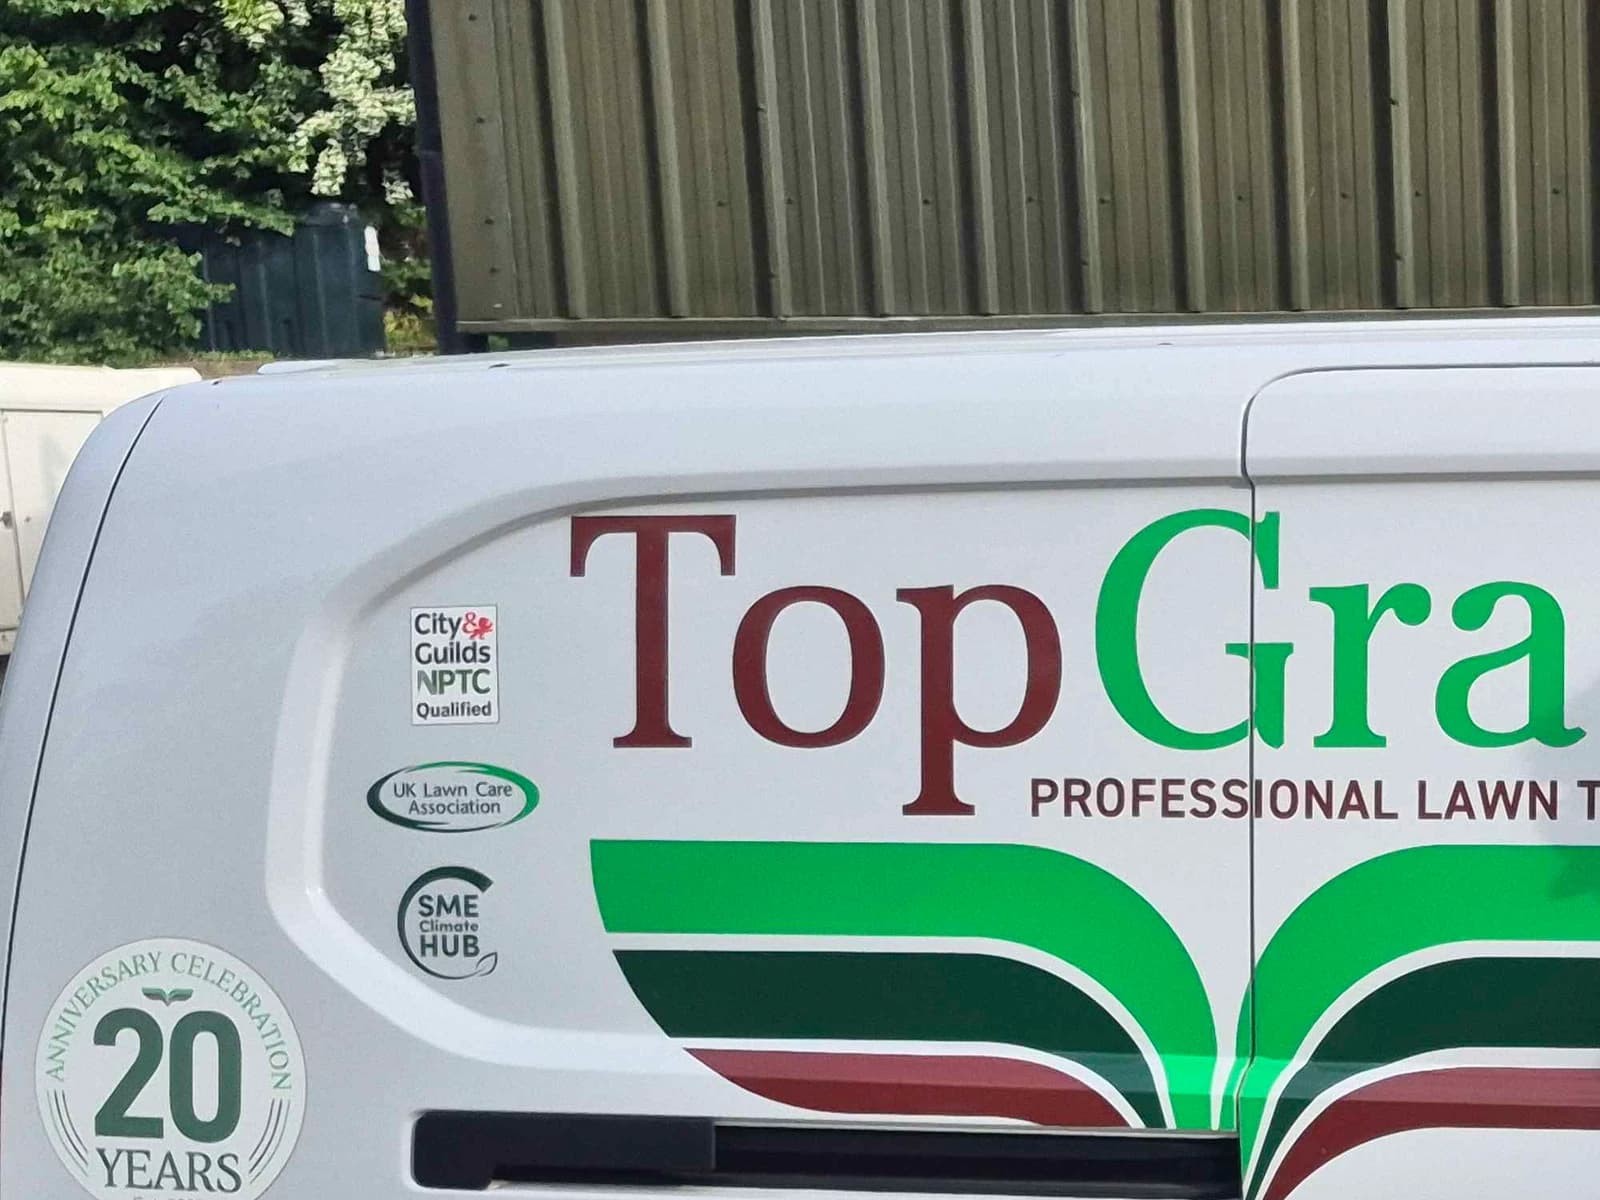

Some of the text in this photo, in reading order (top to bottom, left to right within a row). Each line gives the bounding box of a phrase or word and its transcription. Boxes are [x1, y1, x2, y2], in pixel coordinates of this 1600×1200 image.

[414, 641, 491, 664] Guilds
[416, 669, 491, 695] NPTC
[416, 701, 492, 720] Qualified
[393, 780, 512, 797] UK Lawn Care
[1030, 777, 1398, 822] PROFESSIONAL
[1418, 779, 1559, 822] LAWN
[408, 799, 500, 815] Association
[418, 895, 479, 918] SME
[419, 920, 479, 933] Climate
[419, 934, 480, 957] HUB
[46, 951, 292, 1090] ANNIVERSARY CELEBRATION
[93, 1007, 242, 1144] 20
[96, 1147, 242, 1193] YEARS
